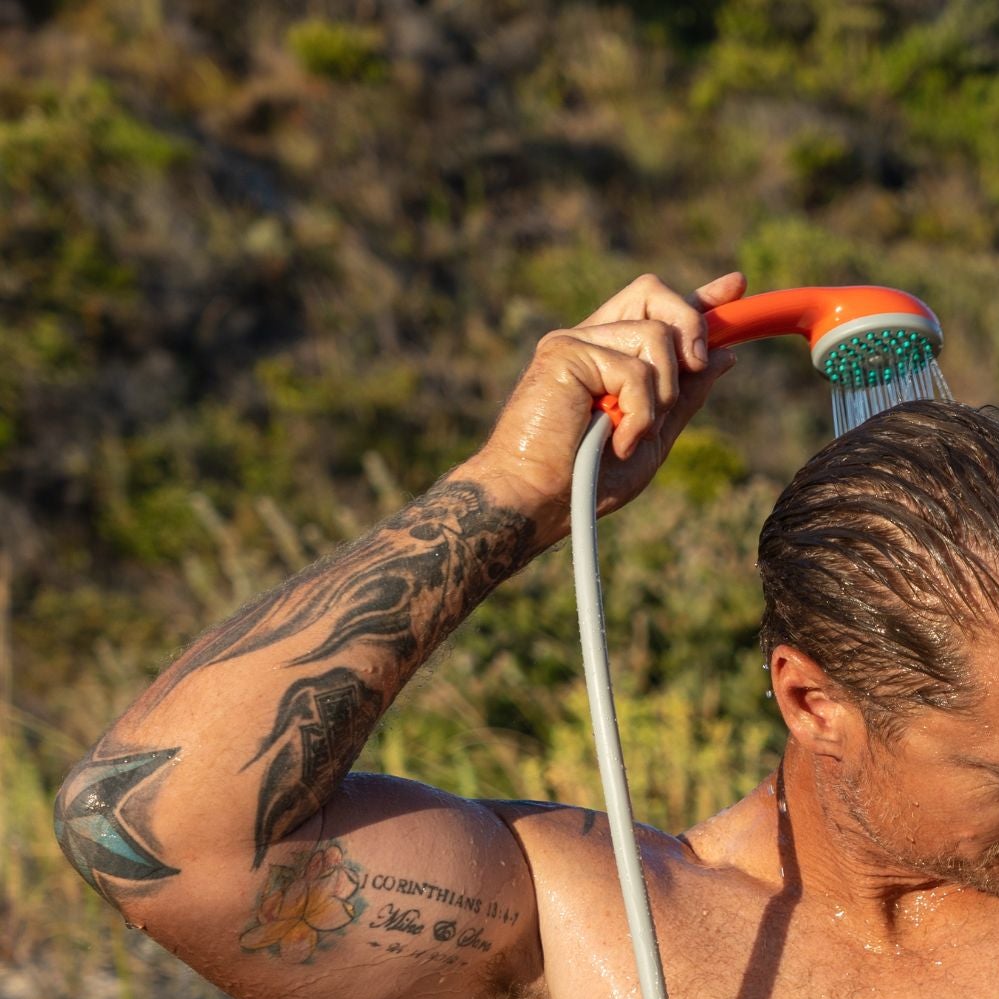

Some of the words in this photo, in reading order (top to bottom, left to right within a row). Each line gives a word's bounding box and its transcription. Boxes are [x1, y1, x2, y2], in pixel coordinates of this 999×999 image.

[371, 873, 482, 914] CORINTHIANS
[368, 903, 425, 936] Mike
[433, 920, 457, 942] &
